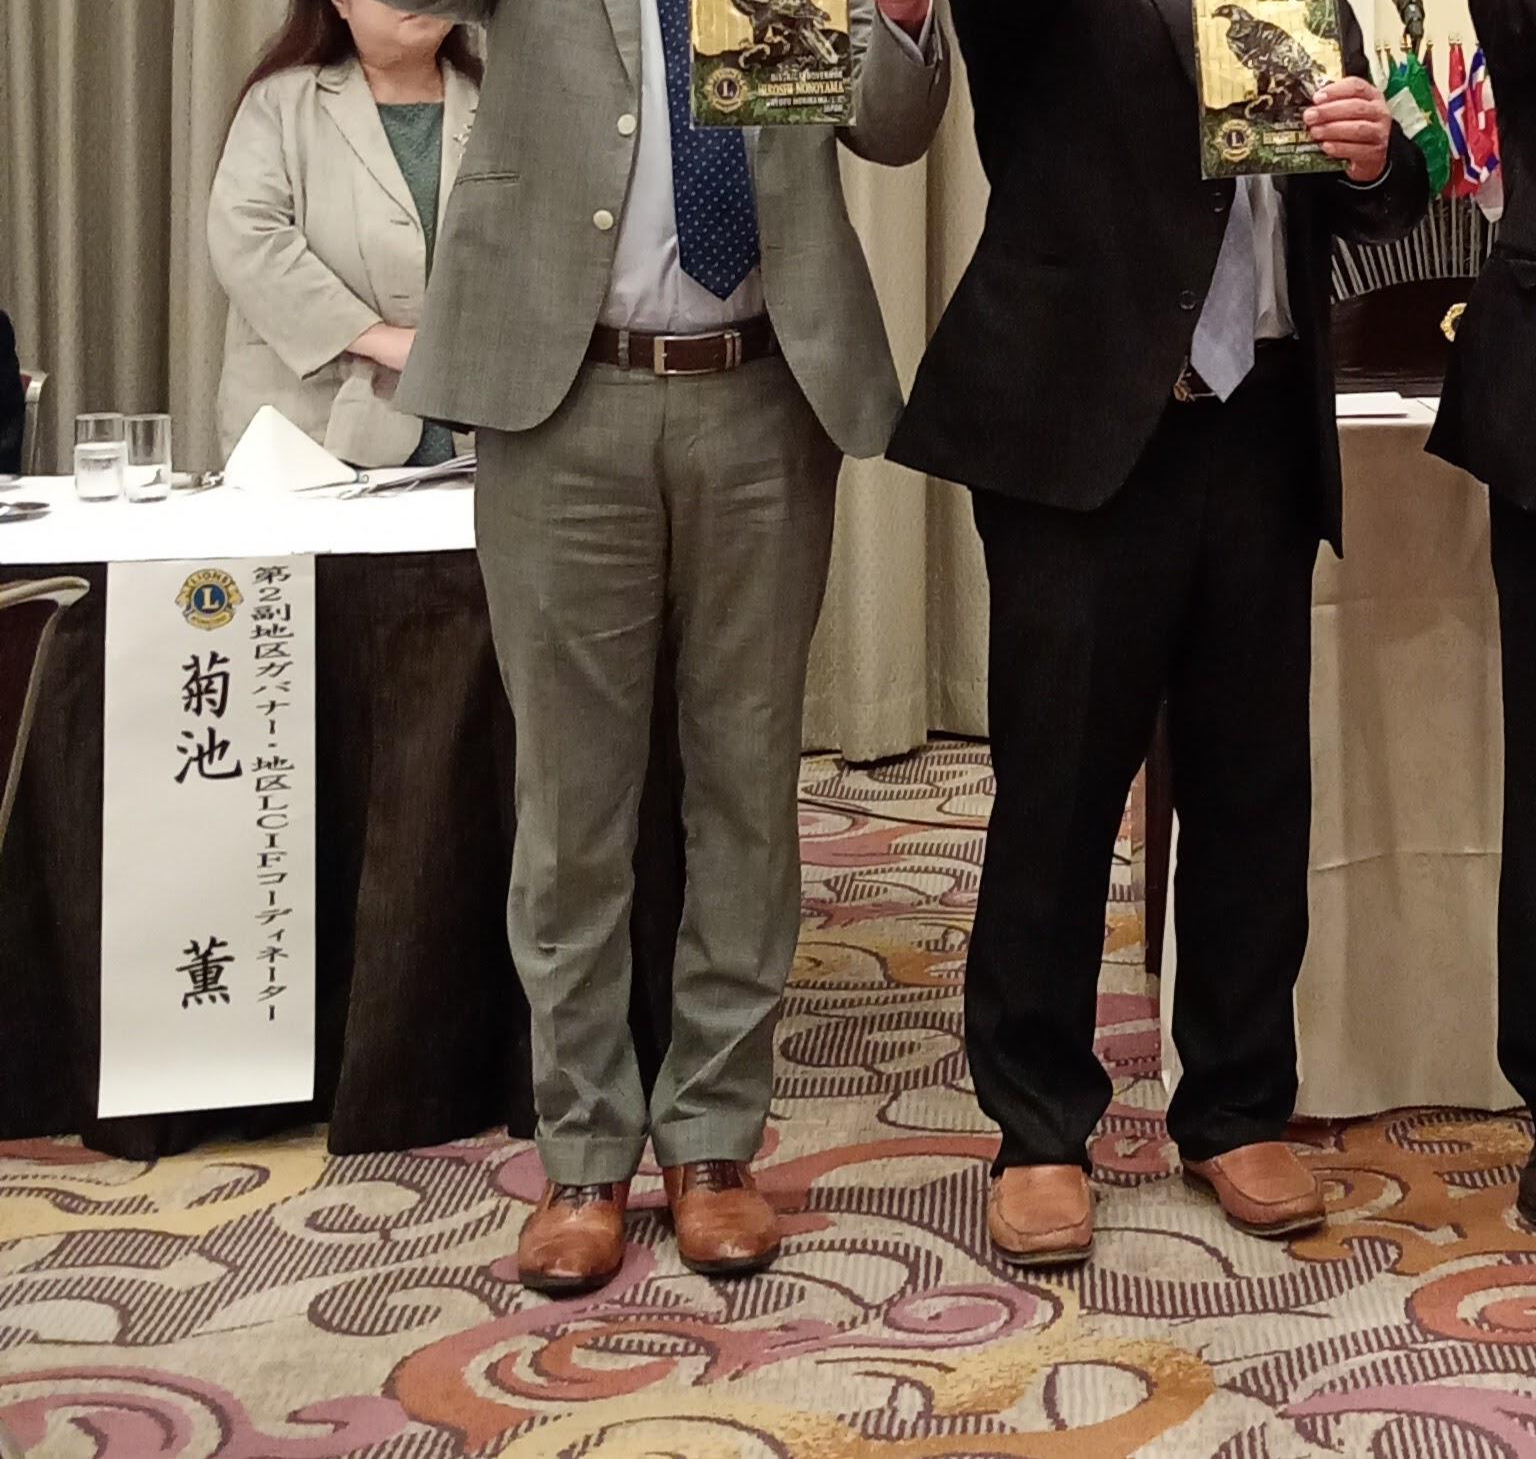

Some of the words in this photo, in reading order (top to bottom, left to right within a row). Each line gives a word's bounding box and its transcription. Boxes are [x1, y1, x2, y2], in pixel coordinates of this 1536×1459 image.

[202, 587, 220, 609] L
[174, 650, 243, 784] 菊池
[175, 935, 236, 1010] 薫
